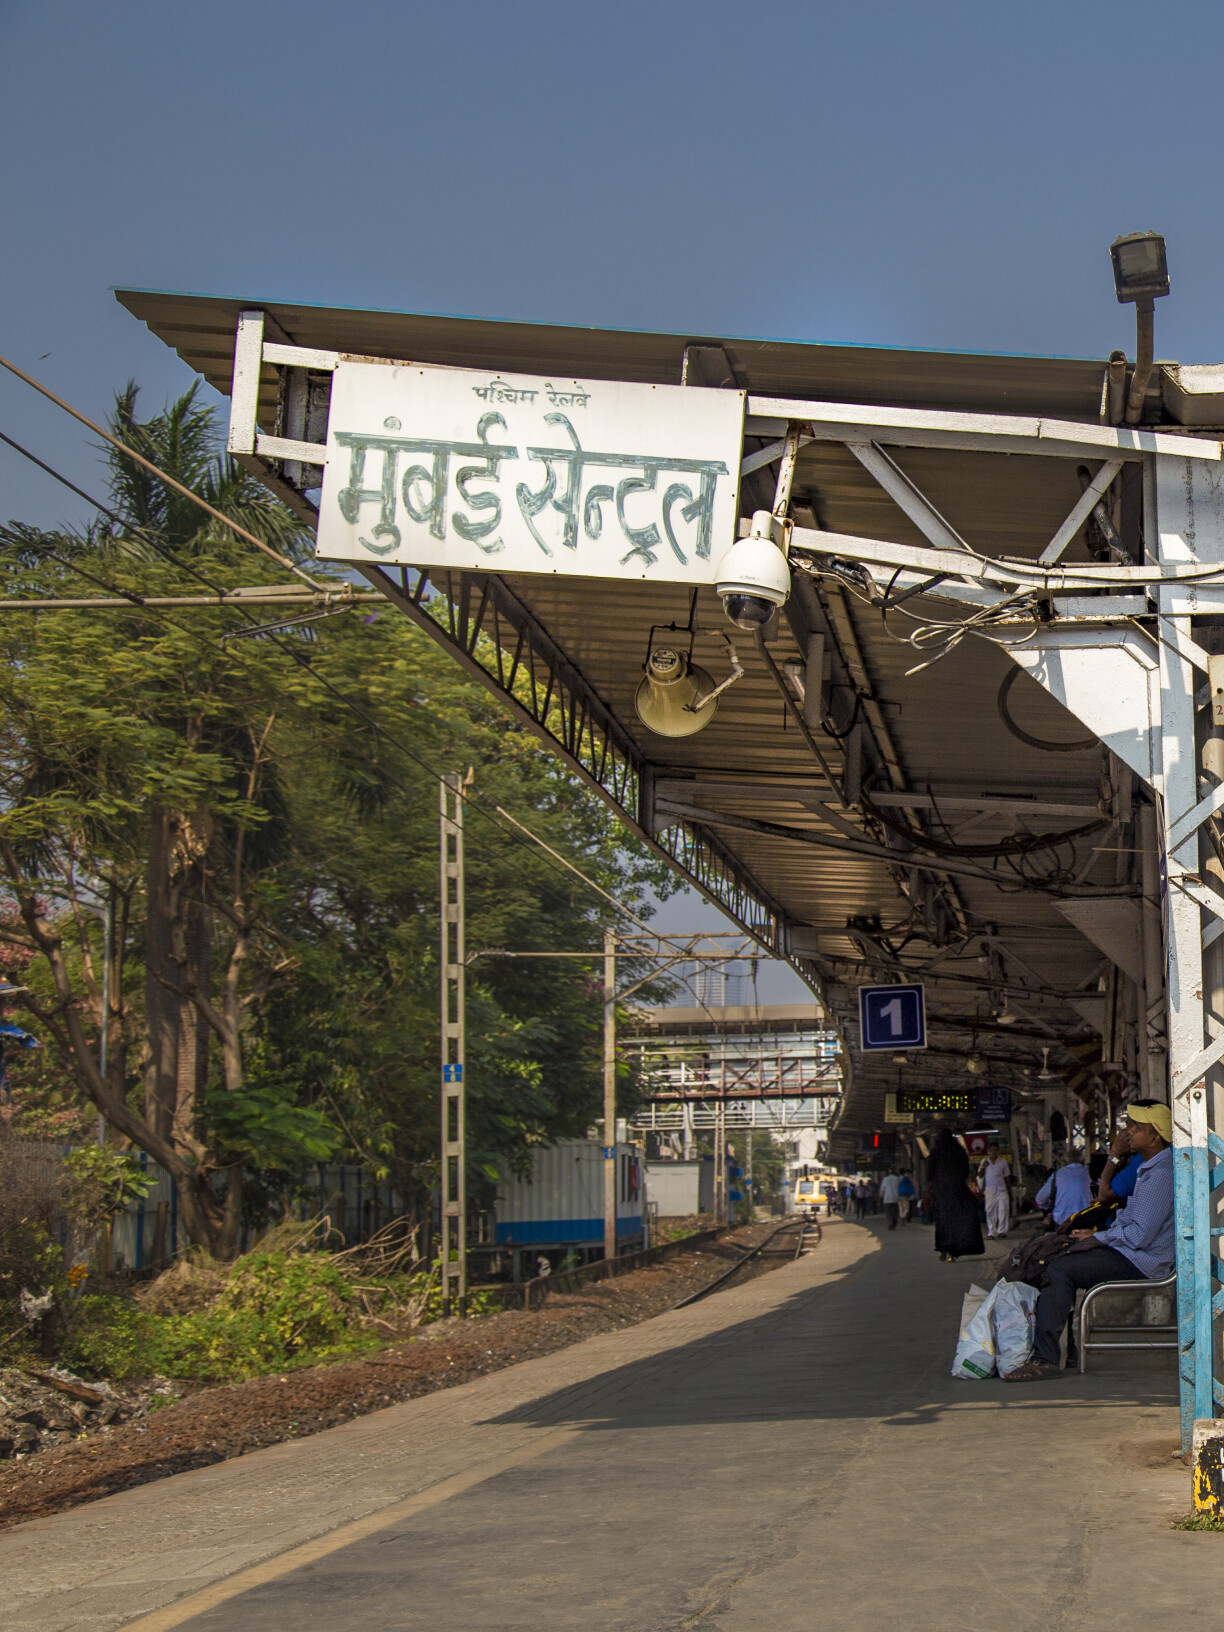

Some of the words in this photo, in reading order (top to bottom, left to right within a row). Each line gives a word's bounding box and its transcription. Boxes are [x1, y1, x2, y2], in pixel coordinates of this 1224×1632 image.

[472, 381, 539, 406] पश्चिम
[545, 382, 591, 408] रेलवे
[334, 411, 519, 555] मुंबई
[880, 998, 903, 1036] 1
